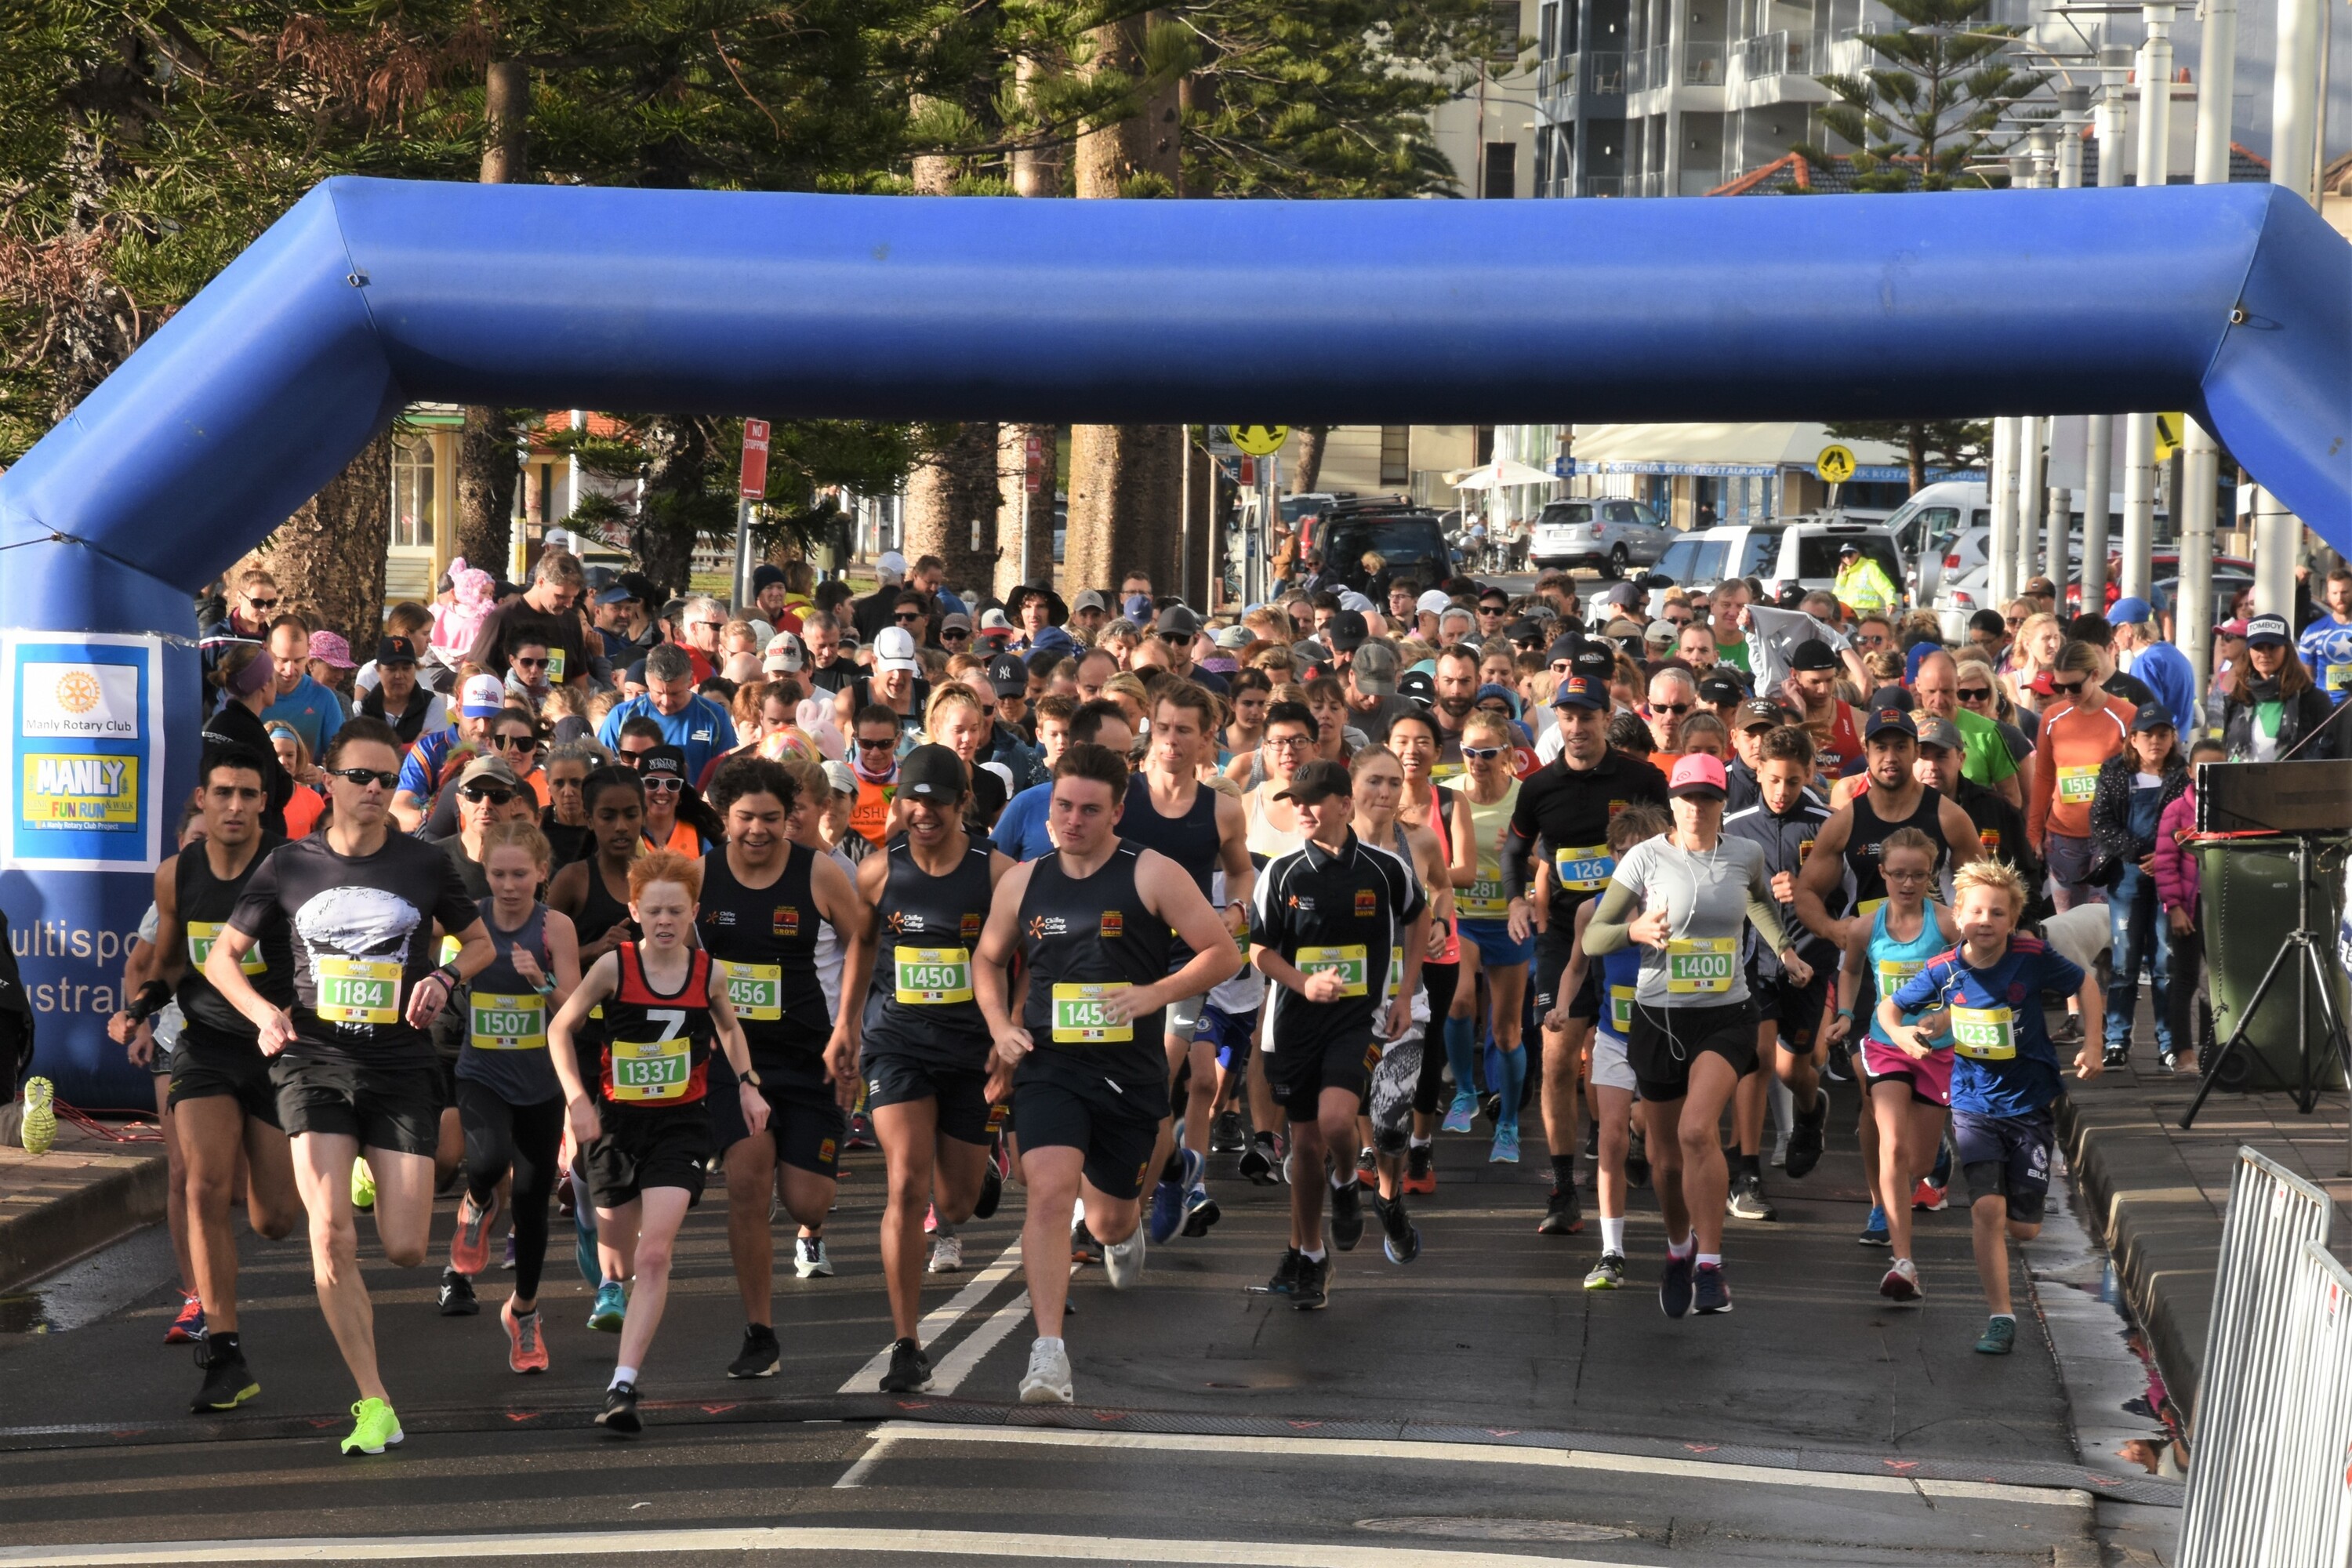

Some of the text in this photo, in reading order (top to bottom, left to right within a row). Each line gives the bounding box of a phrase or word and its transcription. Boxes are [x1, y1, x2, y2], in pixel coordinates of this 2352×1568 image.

[753, 424, 763, 437] NO
[745, 438, 768, 452] STOPPING
[1698, 466, 1773, 477] RESTAURANT
[2249, 622, 2283, 632] TOMBOY
[27, 720, 132, 733] Manly Rotary Club
[37, 758, 125, 796] MANLY
[2067, 777, 2096, 792] 1513
[52, 801, 77, 818] FUN
[79, 802, 106, 819] RUN
[113, 800, 134, 811] WALK
[852, 806, 887, 819] USHL
[48, 821, 64, 830] Manly
[64, 822, 82, 831] Rotary
[98, 823, 119, 832] Project
[1573, 862, 1605, 879] 126
[12, 920, 140, 967] ultispo
[1677, 957, 1726, 978] 1400
[906, 967, 956, 988] 1450
[27, 976, 126, 1013] stral
[334, 980, 383, 1006] 1184
[728, 981, 767, 1004] 456
[484, 1014, 532, 1034] 1507
[647, 1009, 687, 1043] 7
[1958, 1024, 2000, 1046] 1233
[626, 1059, 677, 1084] 1337
[2027, 1168, 2049, 1181] BLK
